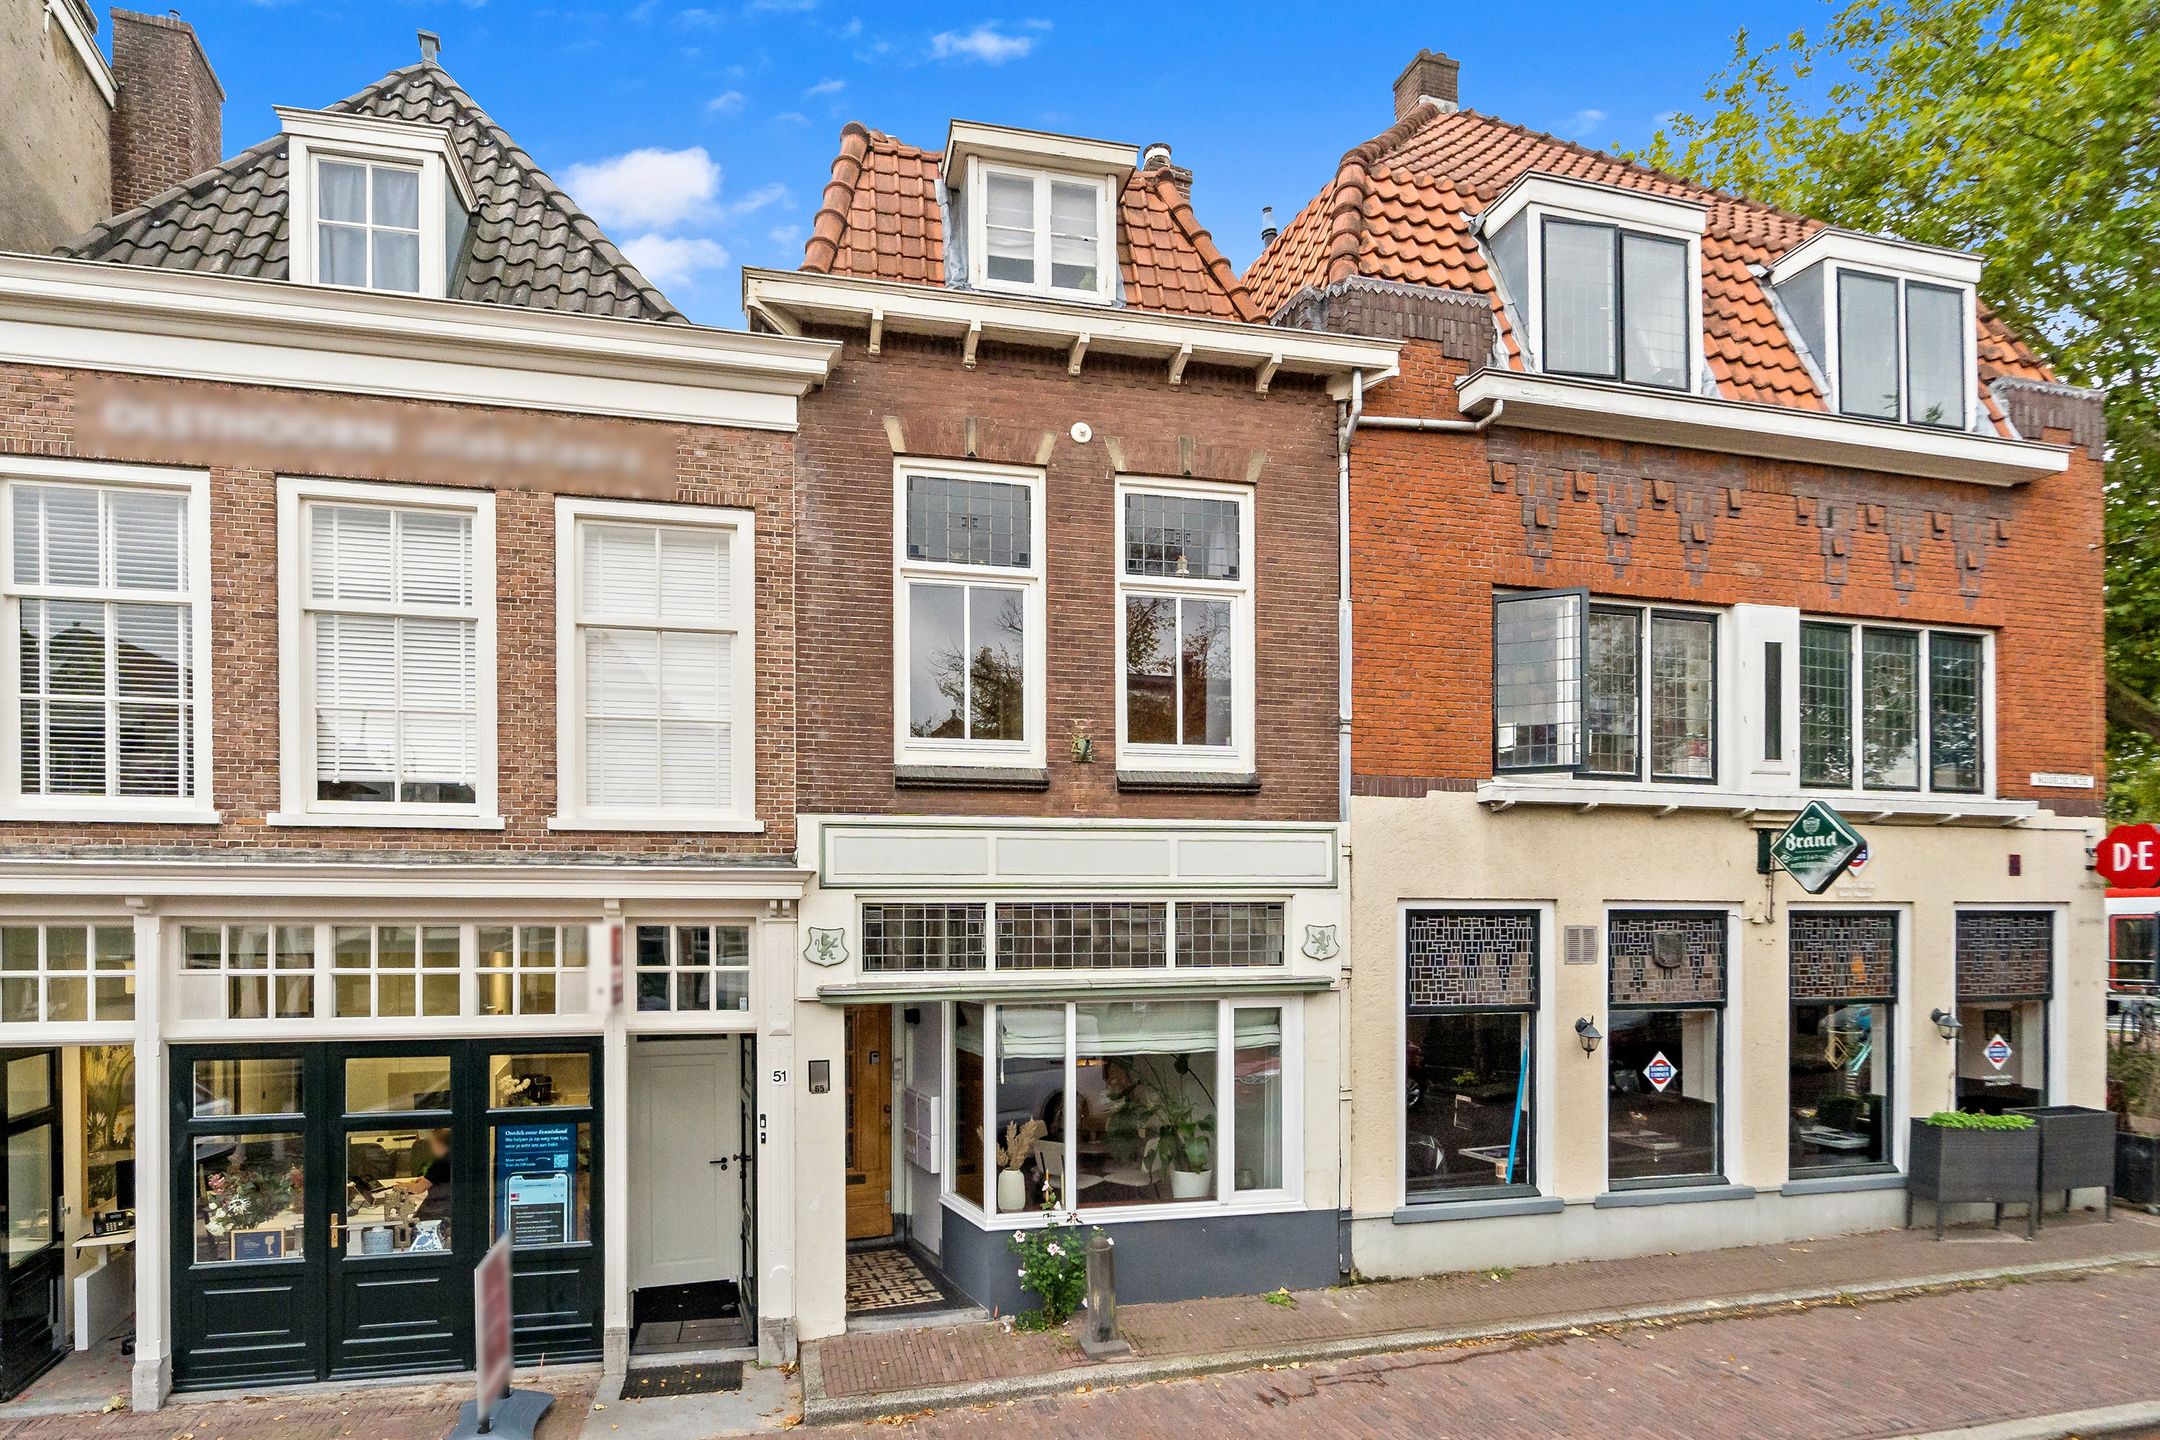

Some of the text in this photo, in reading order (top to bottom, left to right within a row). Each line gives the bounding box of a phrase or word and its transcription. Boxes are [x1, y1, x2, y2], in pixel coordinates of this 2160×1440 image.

[1785, 831, 1838, 851] Brand
[2113, 841, 2154, 871] D-E
[773, 1070, 787, 1082] 51
[815, 1085, 825, 1093] 65
